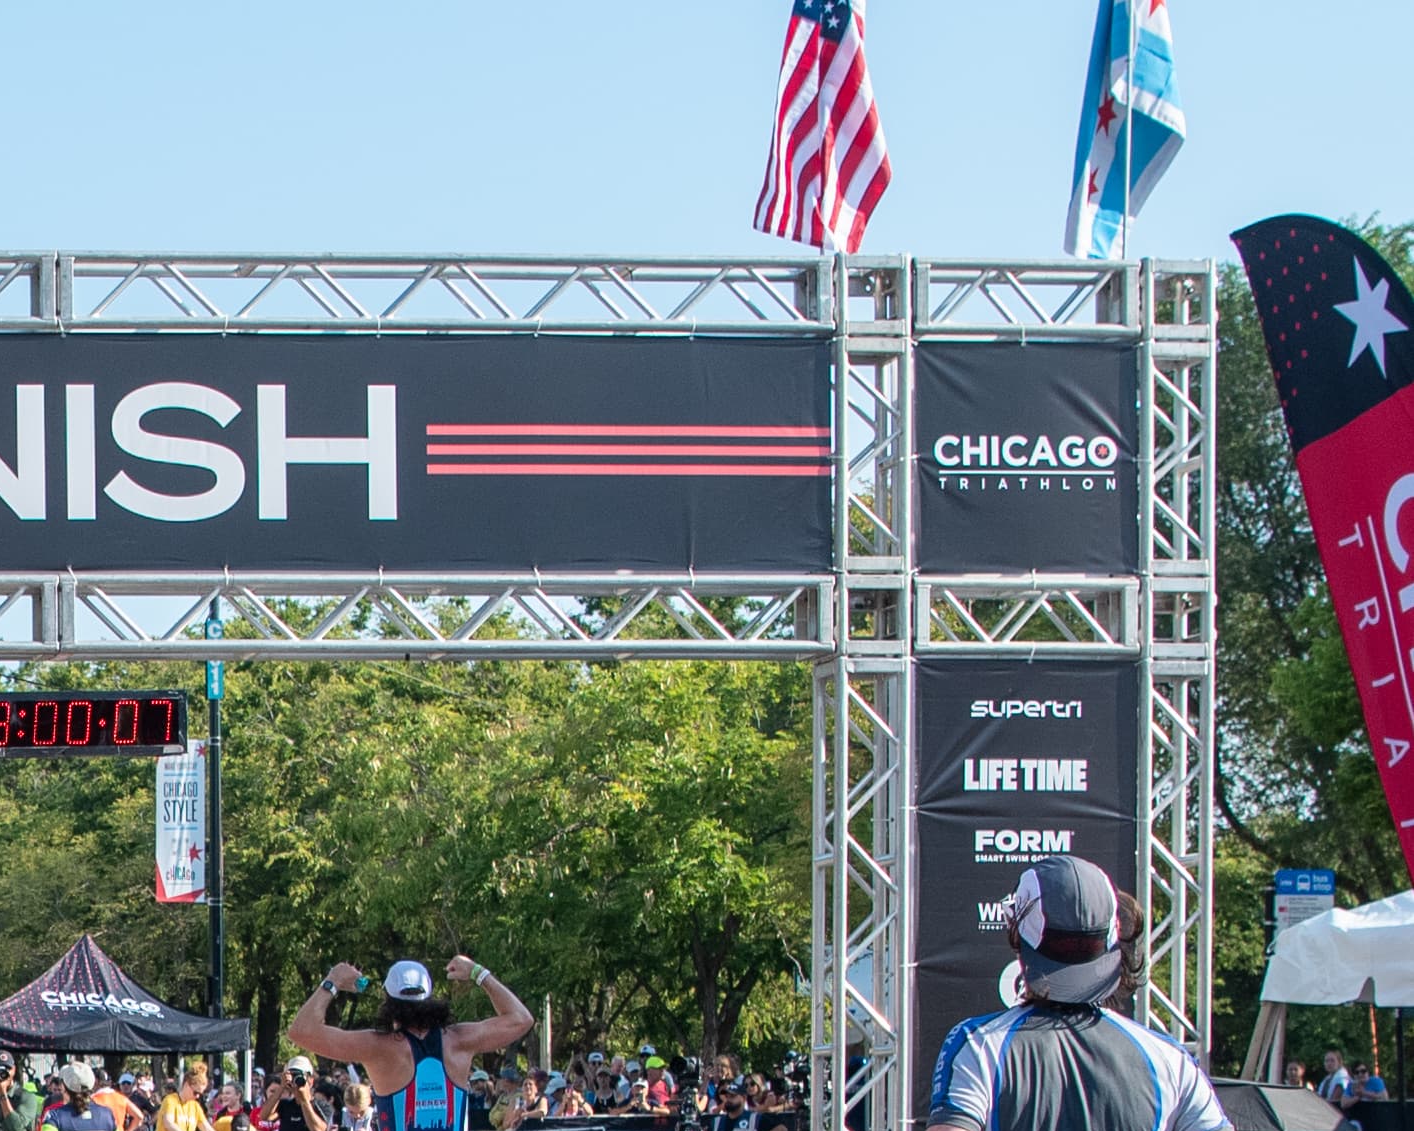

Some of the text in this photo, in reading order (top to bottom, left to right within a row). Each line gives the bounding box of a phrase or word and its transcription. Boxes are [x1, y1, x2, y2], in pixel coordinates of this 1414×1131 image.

[934, 435, 1118, 467] CHICAGO
[938, 477, 1117, 490] TRIATHLON
[970, 700, 1082, 719] supertri
[964, 758, 1088, 791] LIFE TIME
[163, 782, 198, 797] CHICAGO
[163, 800, 198, 822] STYLE
[974, 829, 1073, 853] FORM
[975, 855, 1004, 863] SMART
[1006, 855, 1029, 863] SWIM
[40, 991, 161, 1013] CHICAGO
